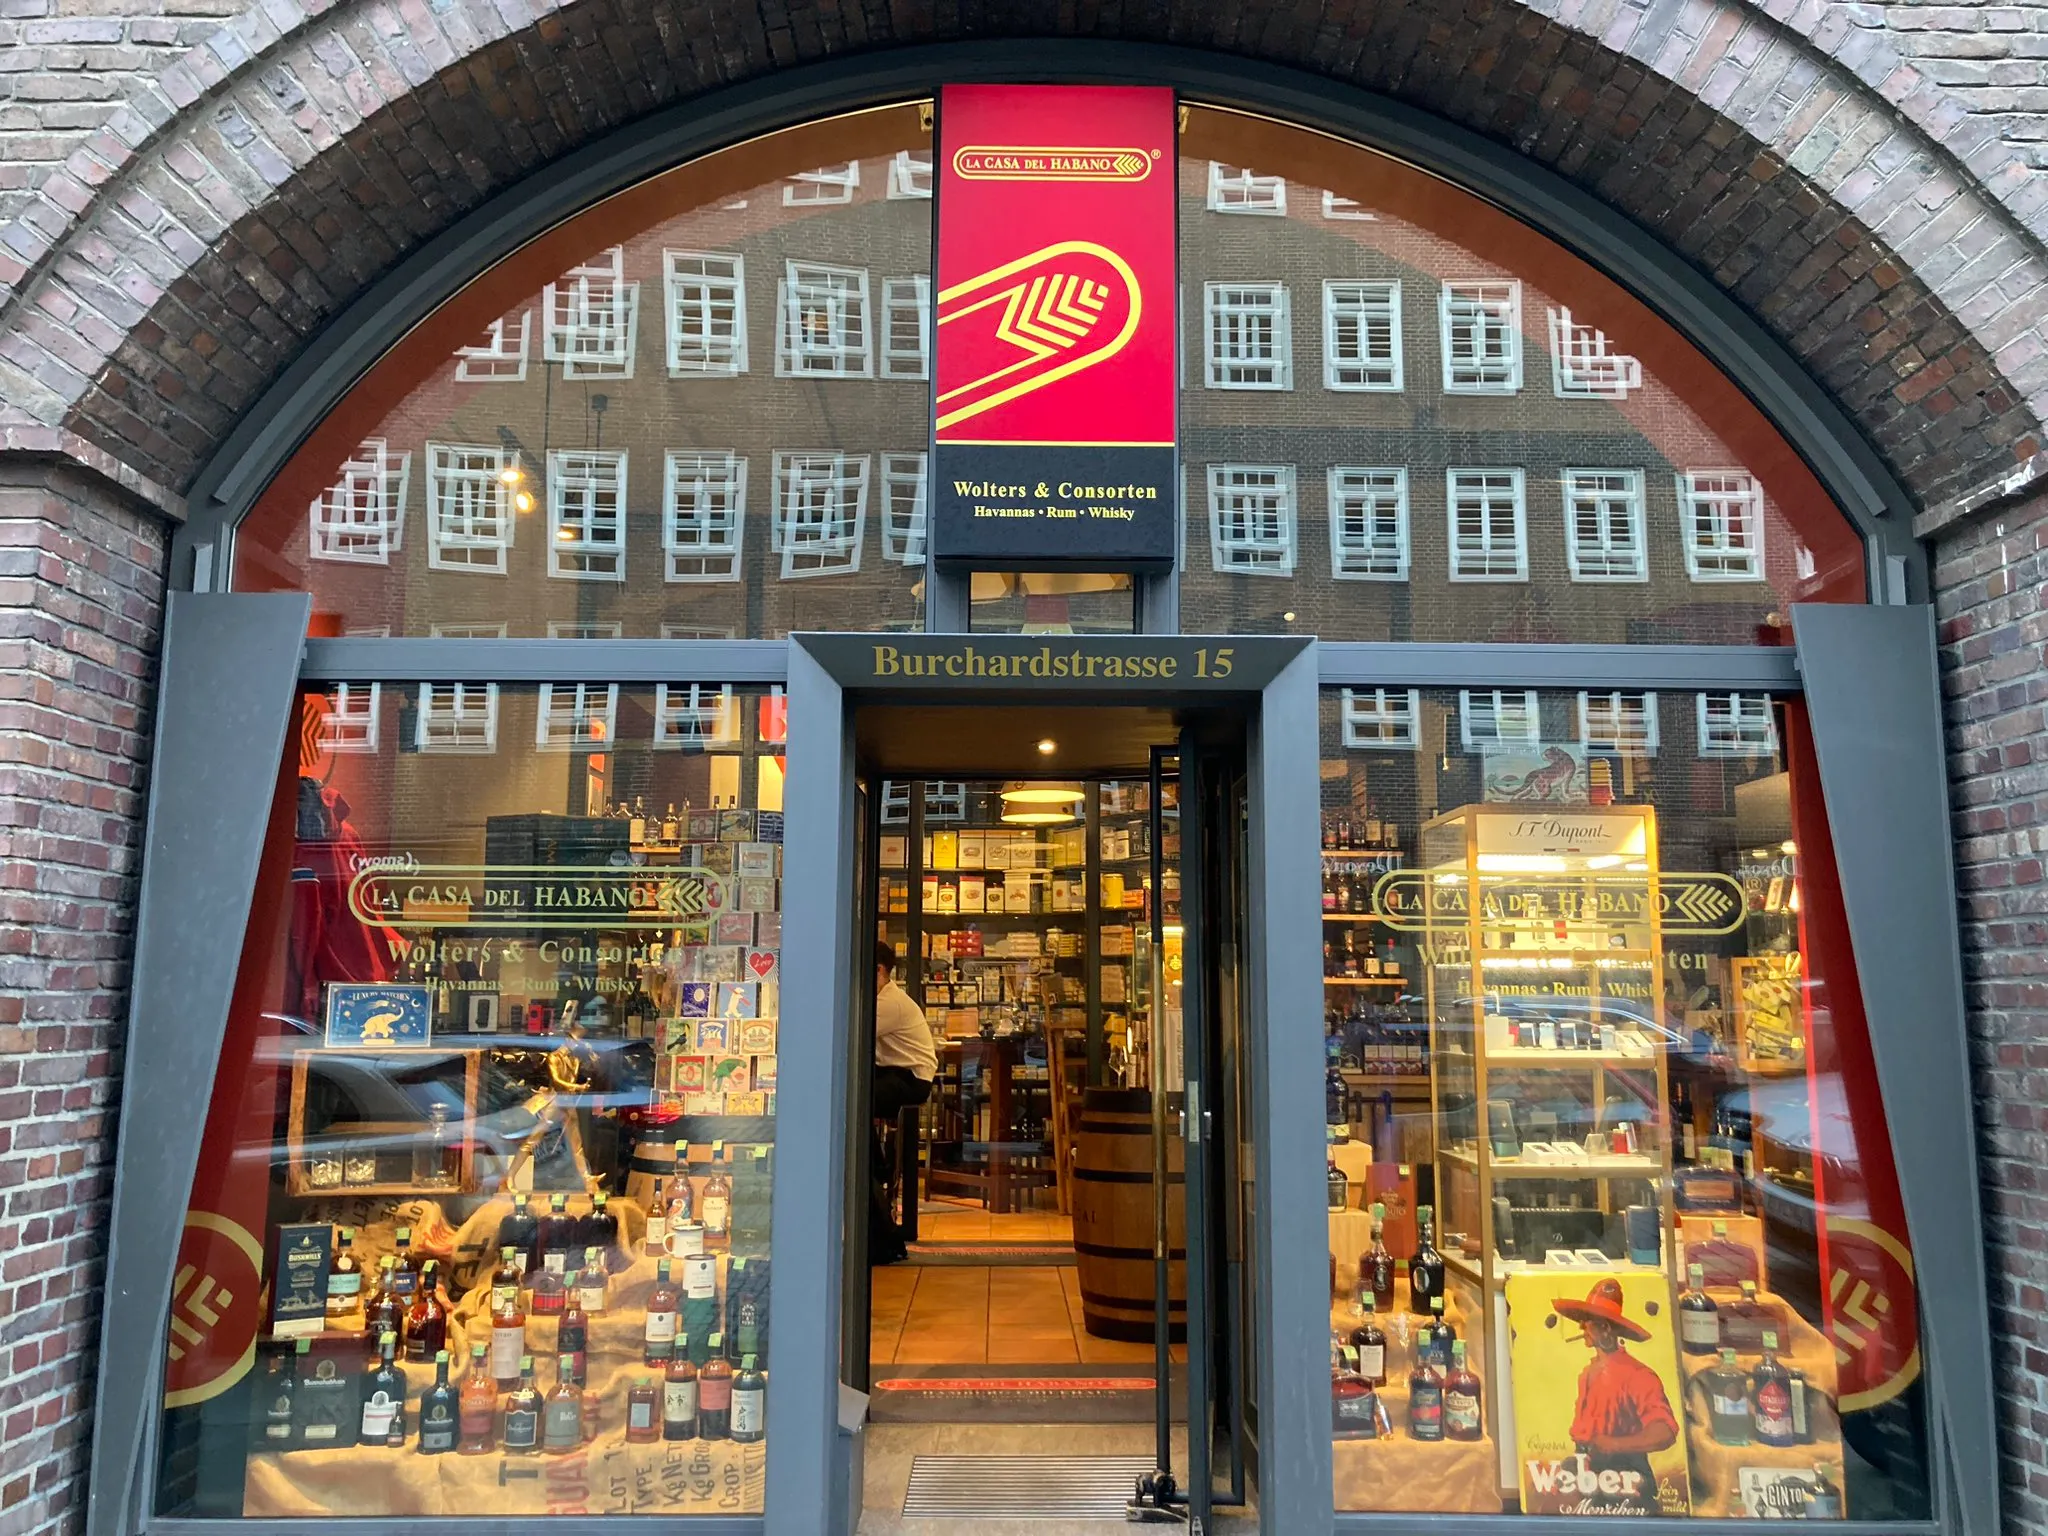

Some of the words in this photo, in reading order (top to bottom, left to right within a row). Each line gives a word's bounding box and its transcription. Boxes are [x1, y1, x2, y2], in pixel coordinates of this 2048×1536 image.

[966, 158, 981, 169] LA
[984, 156, 1020, 170] CASA
[1024, 159, 1046, 170] DEL
[1050, 157, 1111, 171] HABANO
[954, 481, 1027, 498] Wolters
[1034, 482, 1049, 498] &
[1058, 482, 1157, 499] Consorten
[974, 506, 1035, 518] Havannas
[1047, 507, 1077, 518] Rum
[1088, 507, 1135, 521] Whisky
[872, 645, 1177, 678] Burchardstrasse
[1192, 648, 1234, 679] 15
[1543, 820, 1612, 843] Dupont
[373, 888, 399, 907] LA
[407, 886, 475, 906] CASA
[484, 889, 526, 907] DEL
[534, 887, 648, 907] HABANO
[1397, 893, 1424, 910] LA
[1432, 891, 1499, 911] CAA
[387, 940, 491, 962] Wolters
[503, 940, 525, 962] &
[539, 940, 684, 963] Consorten
[425, 977, 504, 991] Havannas
[522, 977, 560, 991] Rum
[577, 977, 638, 994] Whisky
[1553, 982, 1591, 996] Rum
[352, 991, 378, 1001] LUXURY
[1526, 1453, 1641, 1494] Weber
[1653, 1477, 1679, 1500] fein
[1767, 1484, 1790, 1507] GIN
[1662, 1501, 1688, 1513] mild
